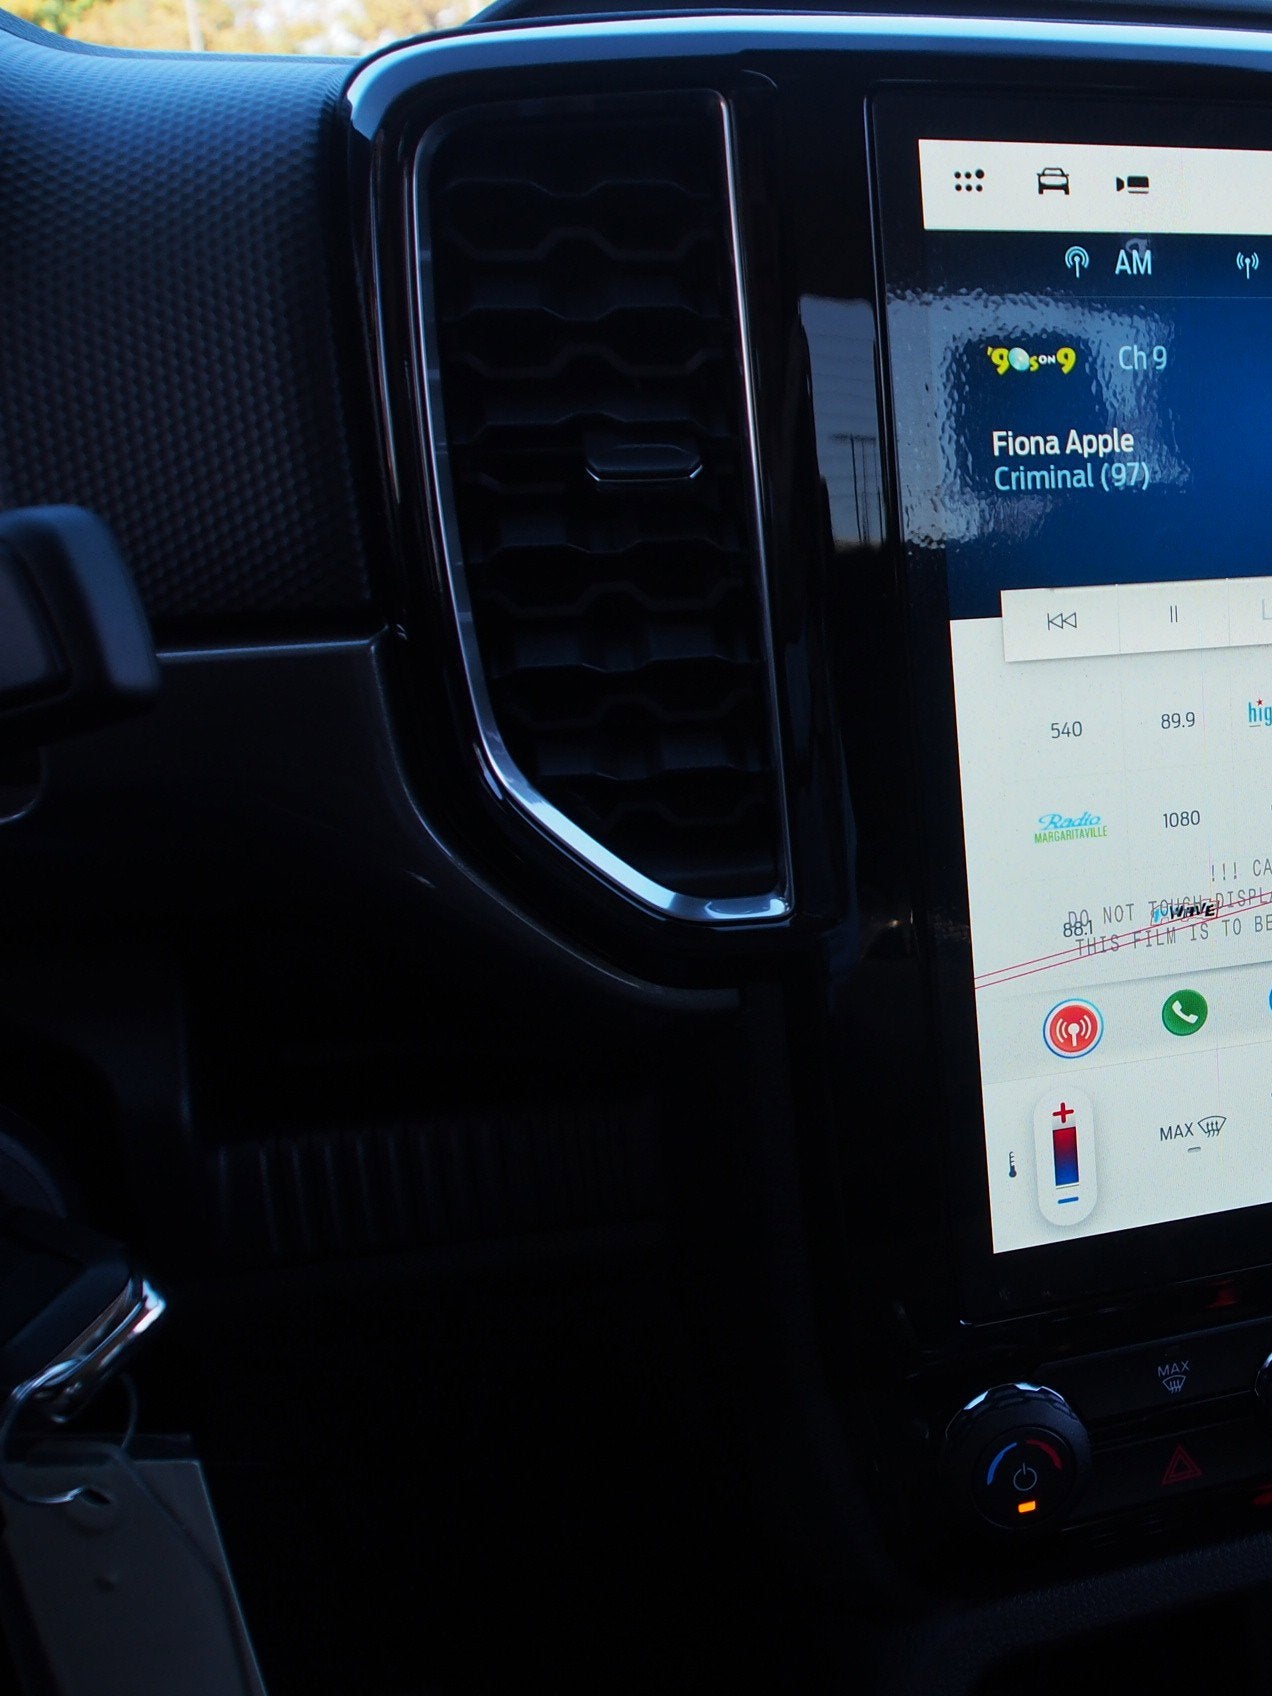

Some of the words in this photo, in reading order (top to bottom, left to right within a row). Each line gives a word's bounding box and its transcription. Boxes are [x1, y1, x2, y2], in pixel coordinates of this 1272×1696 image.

[1115, 250, 1152, 275] AM
[1119, 345, 1147, 370] Ch
[1152, 345, 1168, 370] 9
[992, 430, 1060, 456] Fiona
[1065, 427, 1134, 458] Apple
[994, 462, 1094, 491] Criminal
[1101, 461, 1150, 492] (97)
[1050, 721, 1083, 739] 540
[1160, 712, 1196, 730] 89.9
[1038, 811, 1101, 831] Radio
[1163, 810, 1201, 828] 1080
[1034, 825, 1108, 844] MARGARITAVILLE
[1068, 909, 1090, 927] DO
[1103, 903, 1135, 925] NOT
[1063, 920, 1093, 938] 88.1
[1075, 934, 1121, 956] THIS
[1133, 927, 1176, 949] FILM
[1190, 923, 1209, 941] IS
[1222, 918, 1242, 936] TO
[1160, 1121, 1194, 1141] MAX
[1157, 1360, 1190, 1377] MAX
